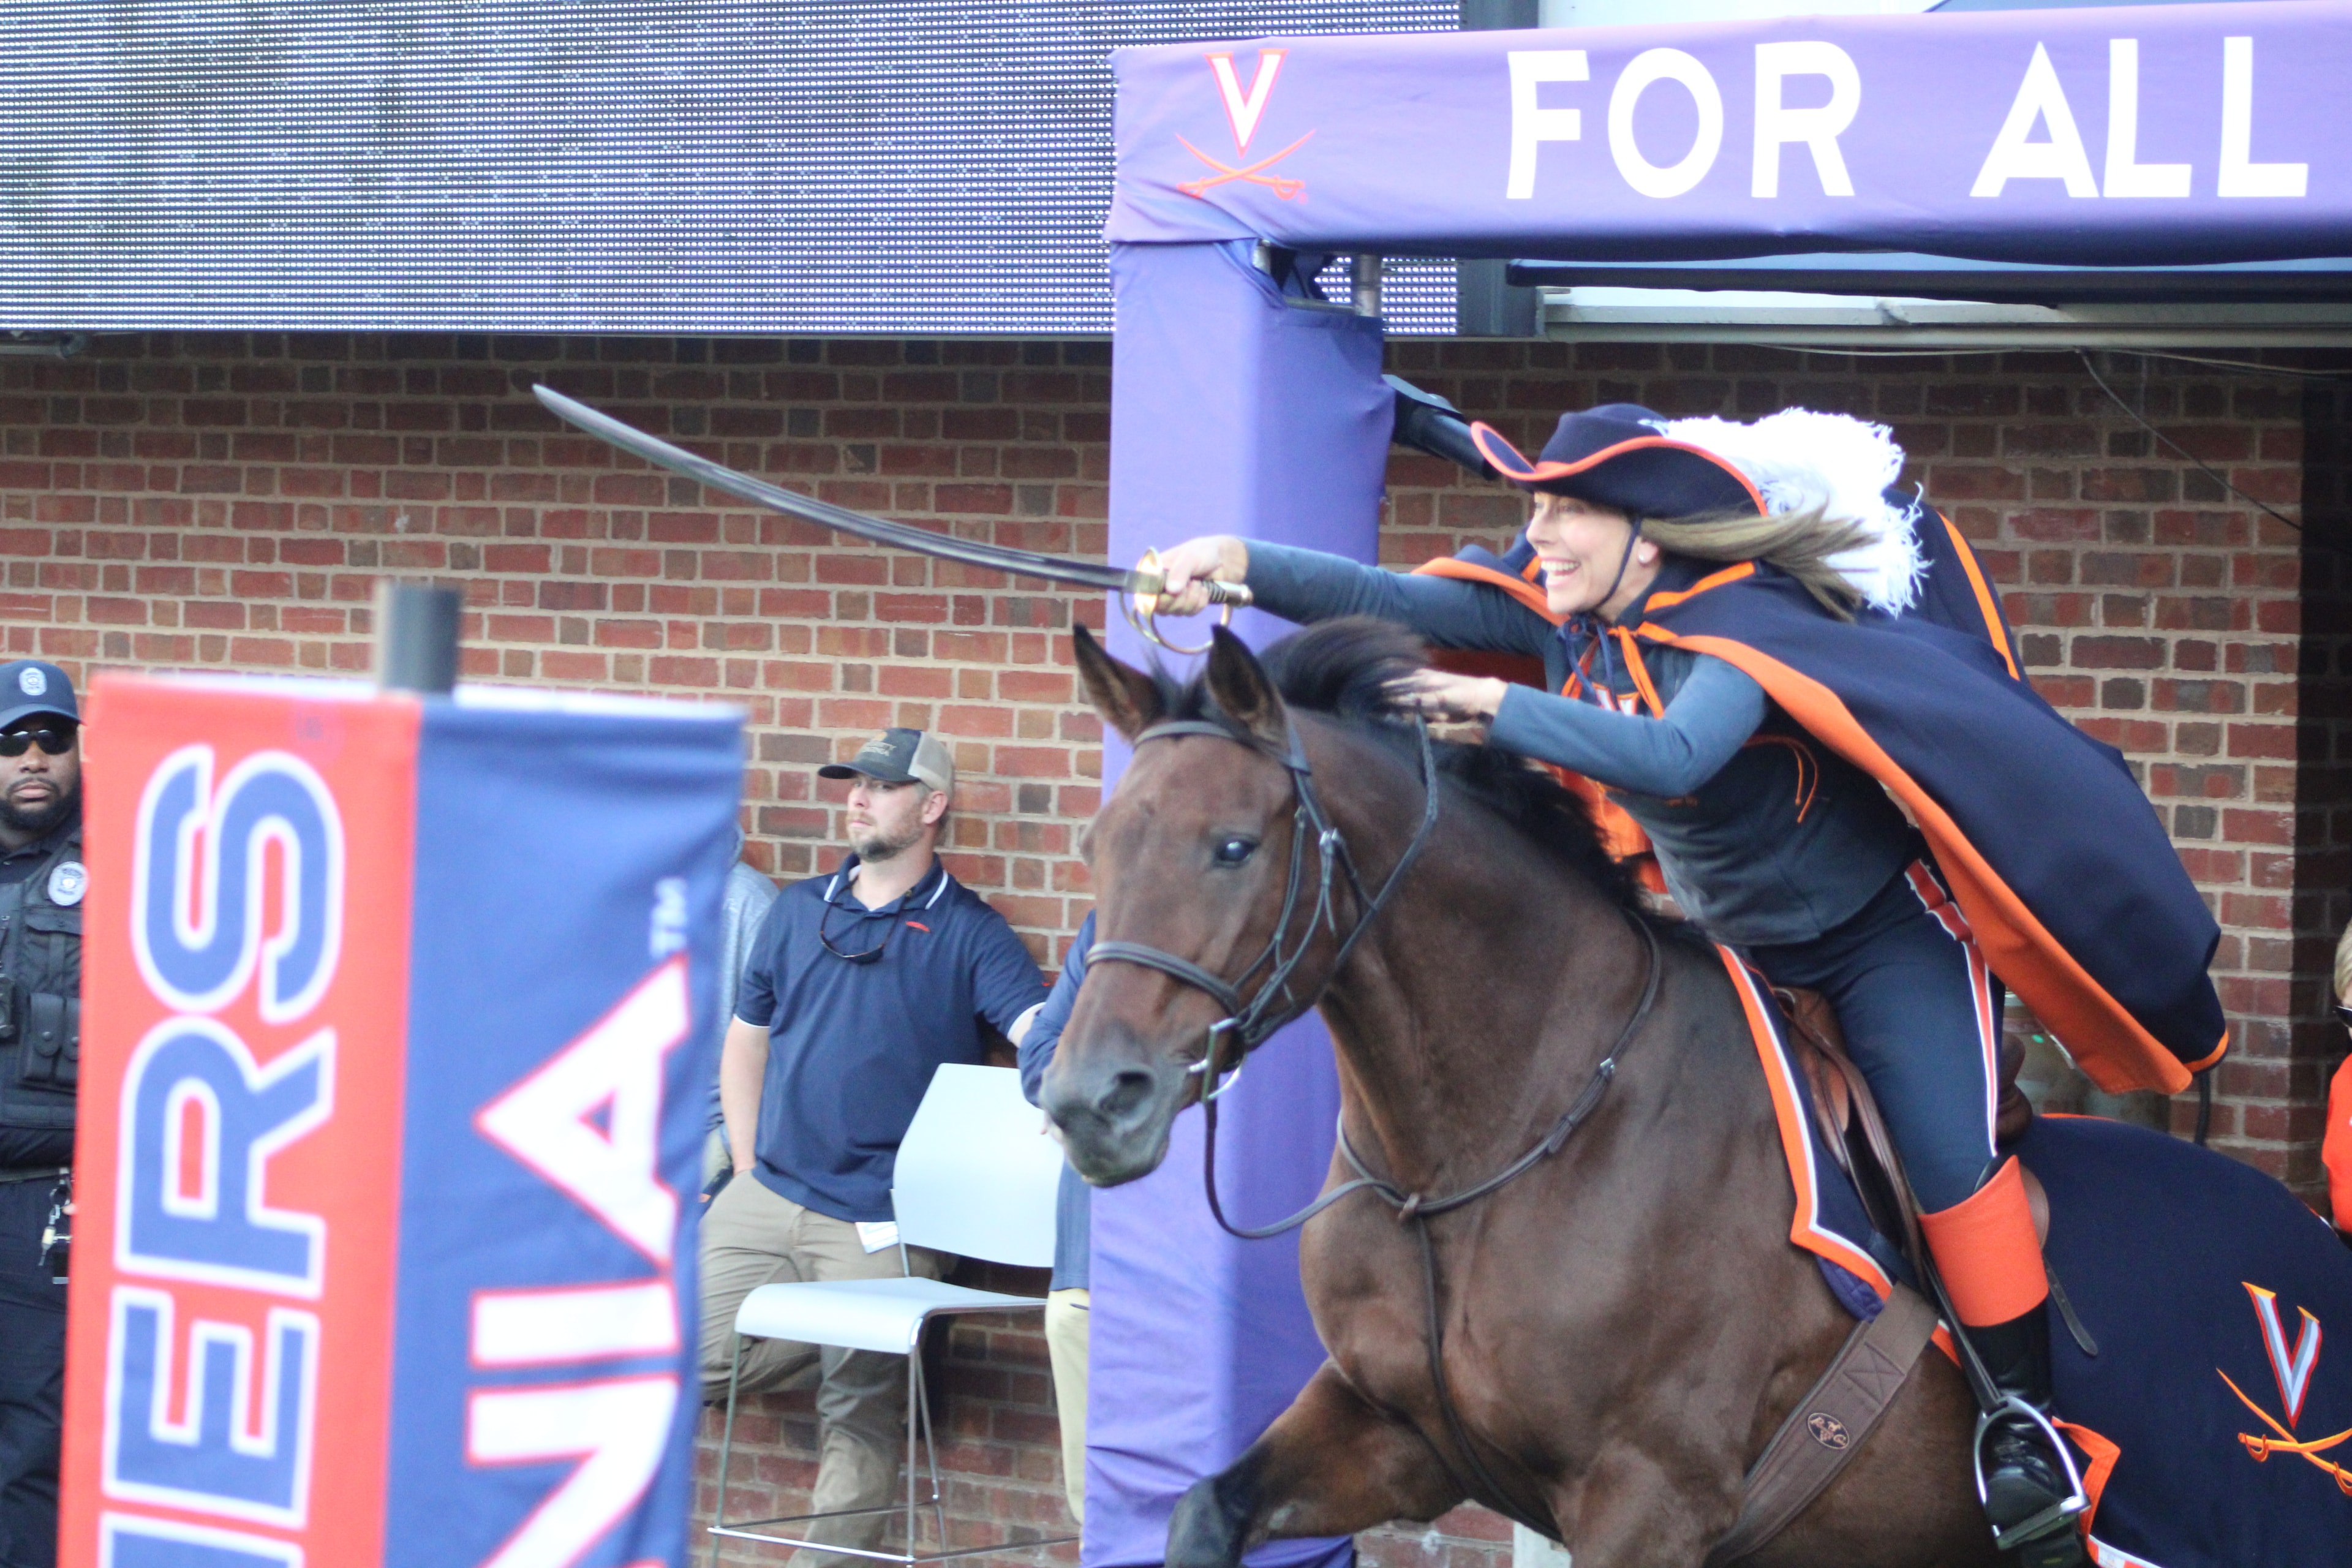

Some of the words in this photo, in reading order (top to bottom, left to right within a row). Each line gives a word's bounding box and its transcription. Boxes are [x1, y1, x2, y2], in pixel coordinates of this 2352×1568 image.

[1202, 49, 1290, 160] V
[1506, 42, 1862, 200] FOR
[1969, 37, 2309, 198] ALL
[2240, 1281, 2323, 1430] V
